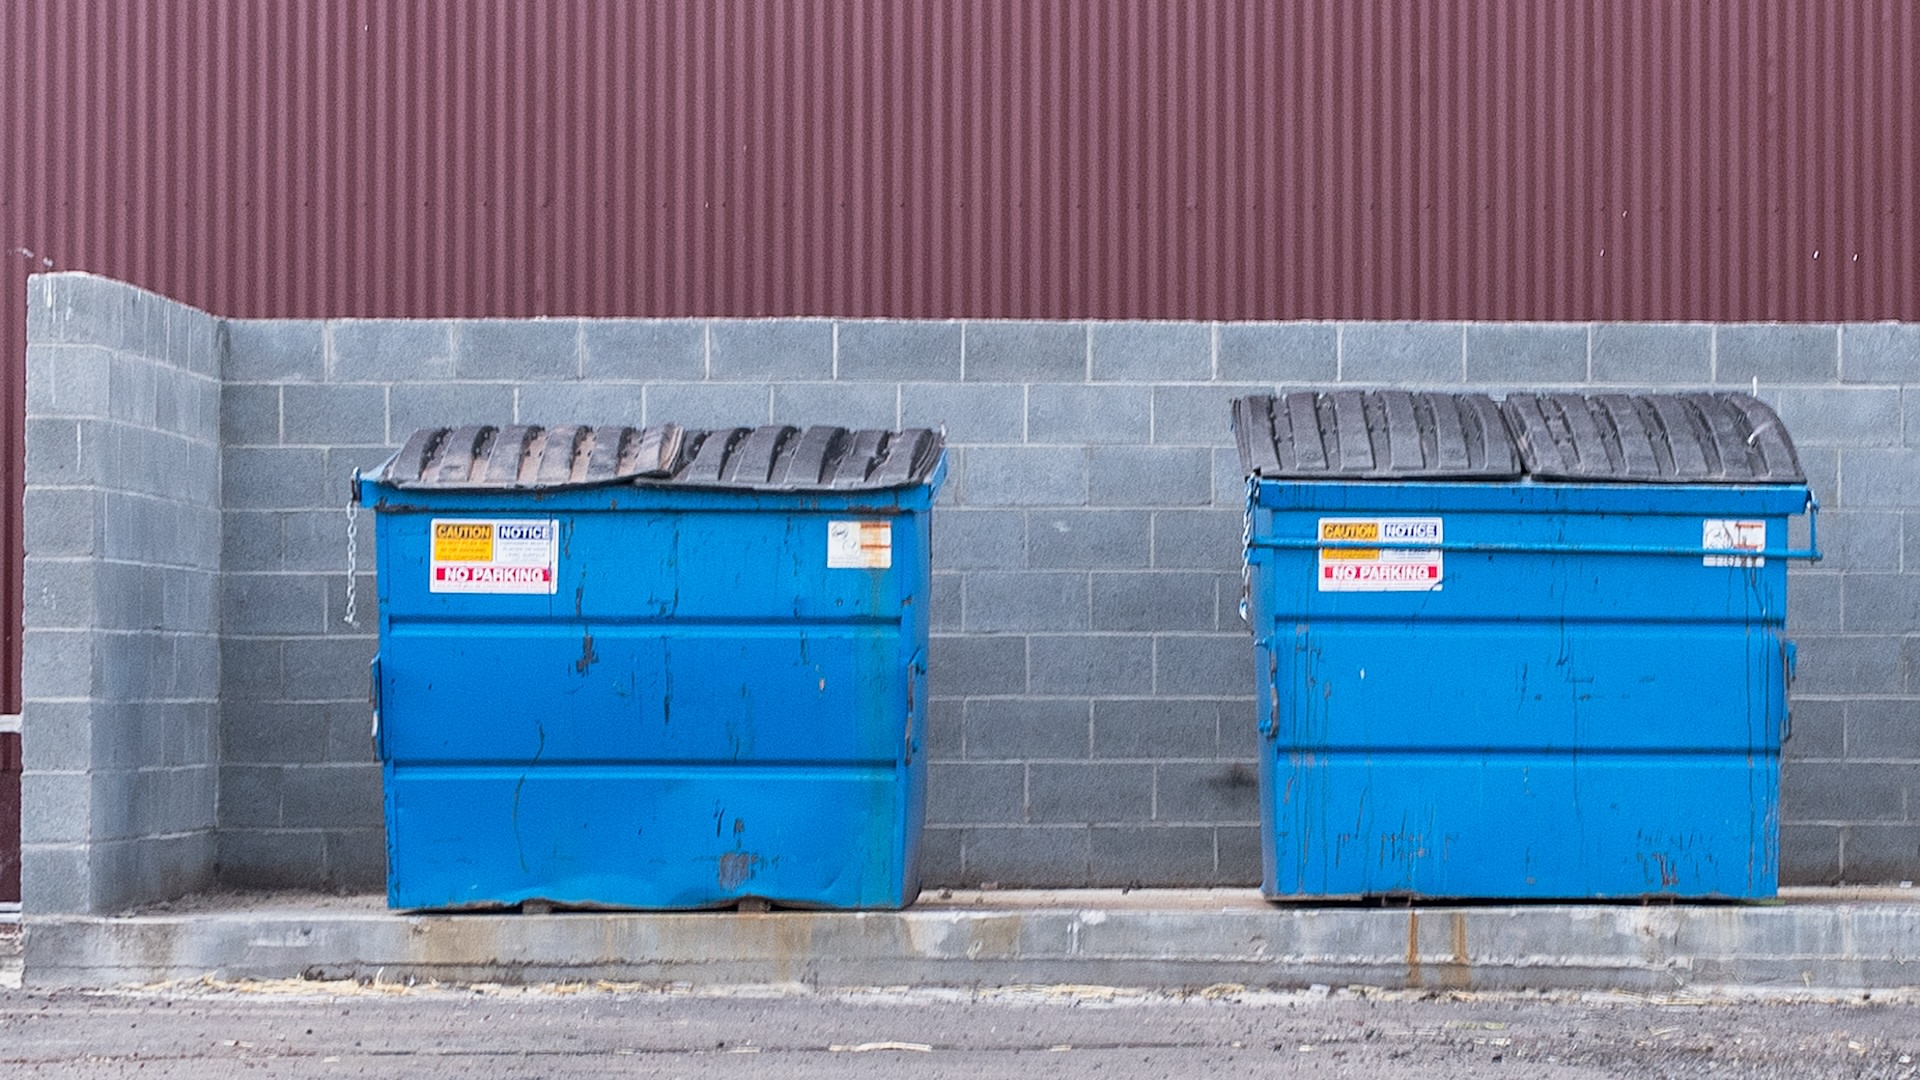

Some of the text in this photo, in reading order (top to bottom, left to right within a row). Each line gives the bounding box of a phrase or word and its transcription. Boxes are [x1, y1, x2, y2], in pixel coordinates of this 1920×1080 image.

[437, 525, 490, 539] CAUTION
[500, 526, 551, 539] NOTICE
[1324, 524, 1377, 538] CAUTION
[1386, 524, 1435, 537] NOTICE
[444, 567, 544, 582] NO PARKING
[1332, 566, 1429, 580] NO PARKING
